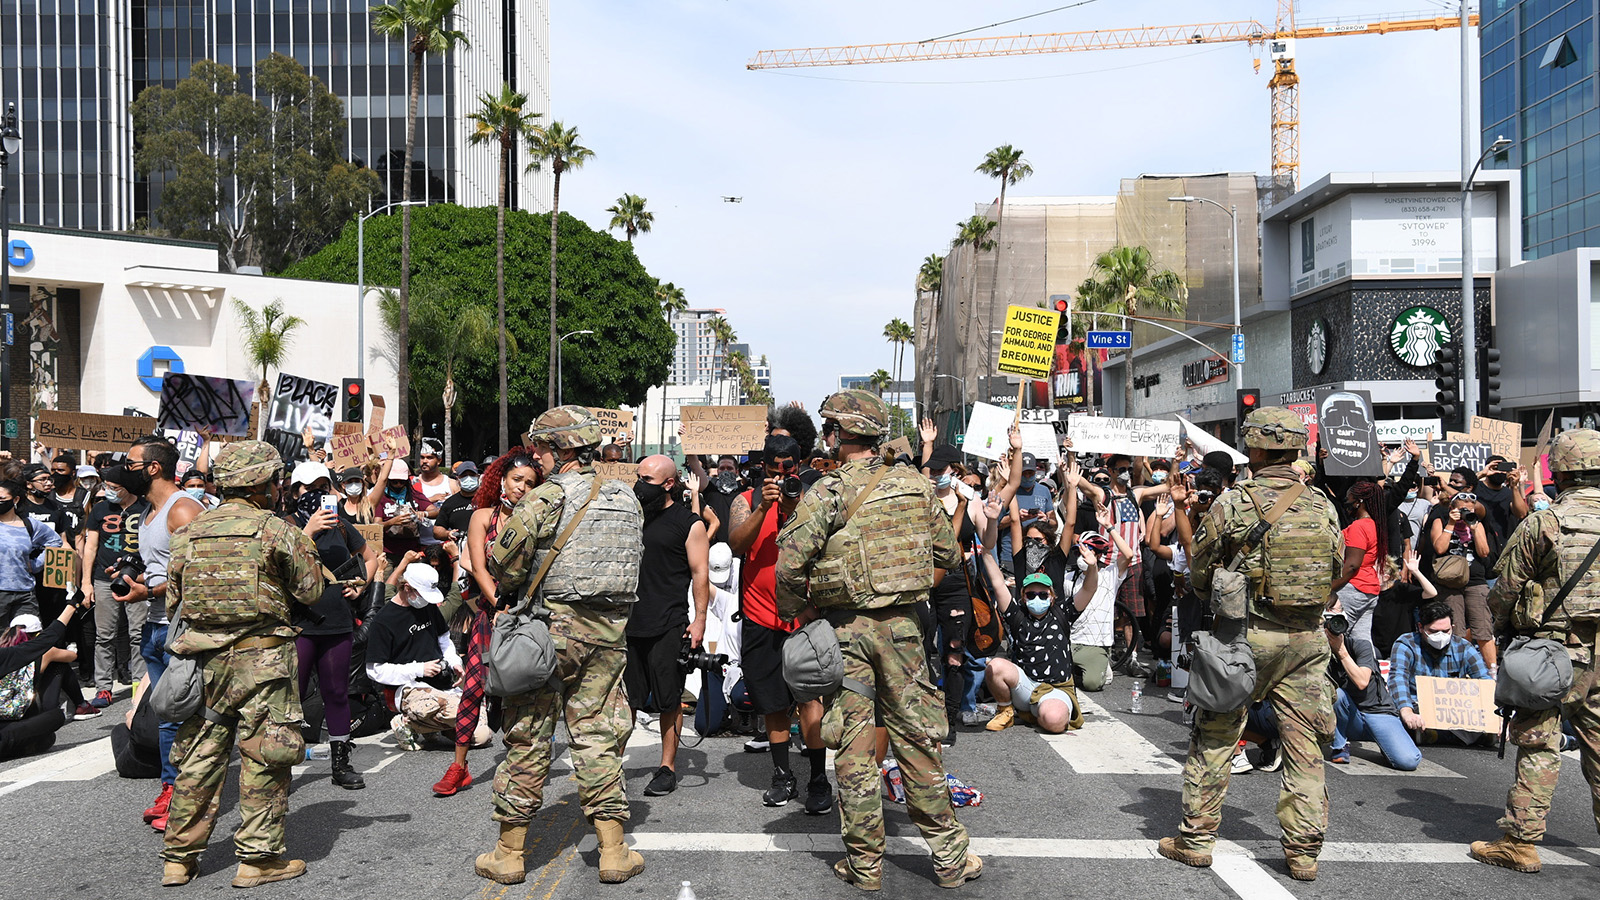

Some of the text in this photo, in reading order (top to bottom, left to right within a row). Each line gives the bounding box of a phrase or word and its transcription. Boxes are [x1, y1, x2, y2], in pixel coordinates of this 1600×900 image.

[1412, 238, 1436, 246] 31996
[1012, 310, 1053, 326] JUSTICE
[1006, 326, 1022, 336] FOR
[1092, 335, 1127, 344] Vine St
[1036, 342, 1052, 352] AND
[1001, 350, 1050, 366] BREONNA!
[1056, 372, 1078, 397] RUN
[278, 375, 337, 410] BLACK
[1280, 390, 1310, 404] STARBUCKS
[686, 408, 745, 421] WE WILL
[1021, 410, 1054, 423] RIP
[40, 422, 77, 437] Black
[81, 425, 108, 438] Lives
[598, 419, 628, 428] CISM
[690, 422, 742, 434] FOREVER
[1472, 418, 1509, 434] BLACK
[1377, 425, 1435, 436] e're Open!
[330, 434, 362, 450] LATINO
[1482, 431, 1513, 444] LIVES
[338, 446, 354, 458] CON
[1434, 444, 1490, 458] I CAN'T
[352, 452, 370, 466] BLM
[1434, 456, 1486, 472] BREATH
[360, 530, 380, 542] TICE
[104, 533, 140, 553] 45
[818, 574, 830, 582] US
[1435, 696, 1472, 708] BRING
[1436, 707, 1486, 727] JUSTICE
